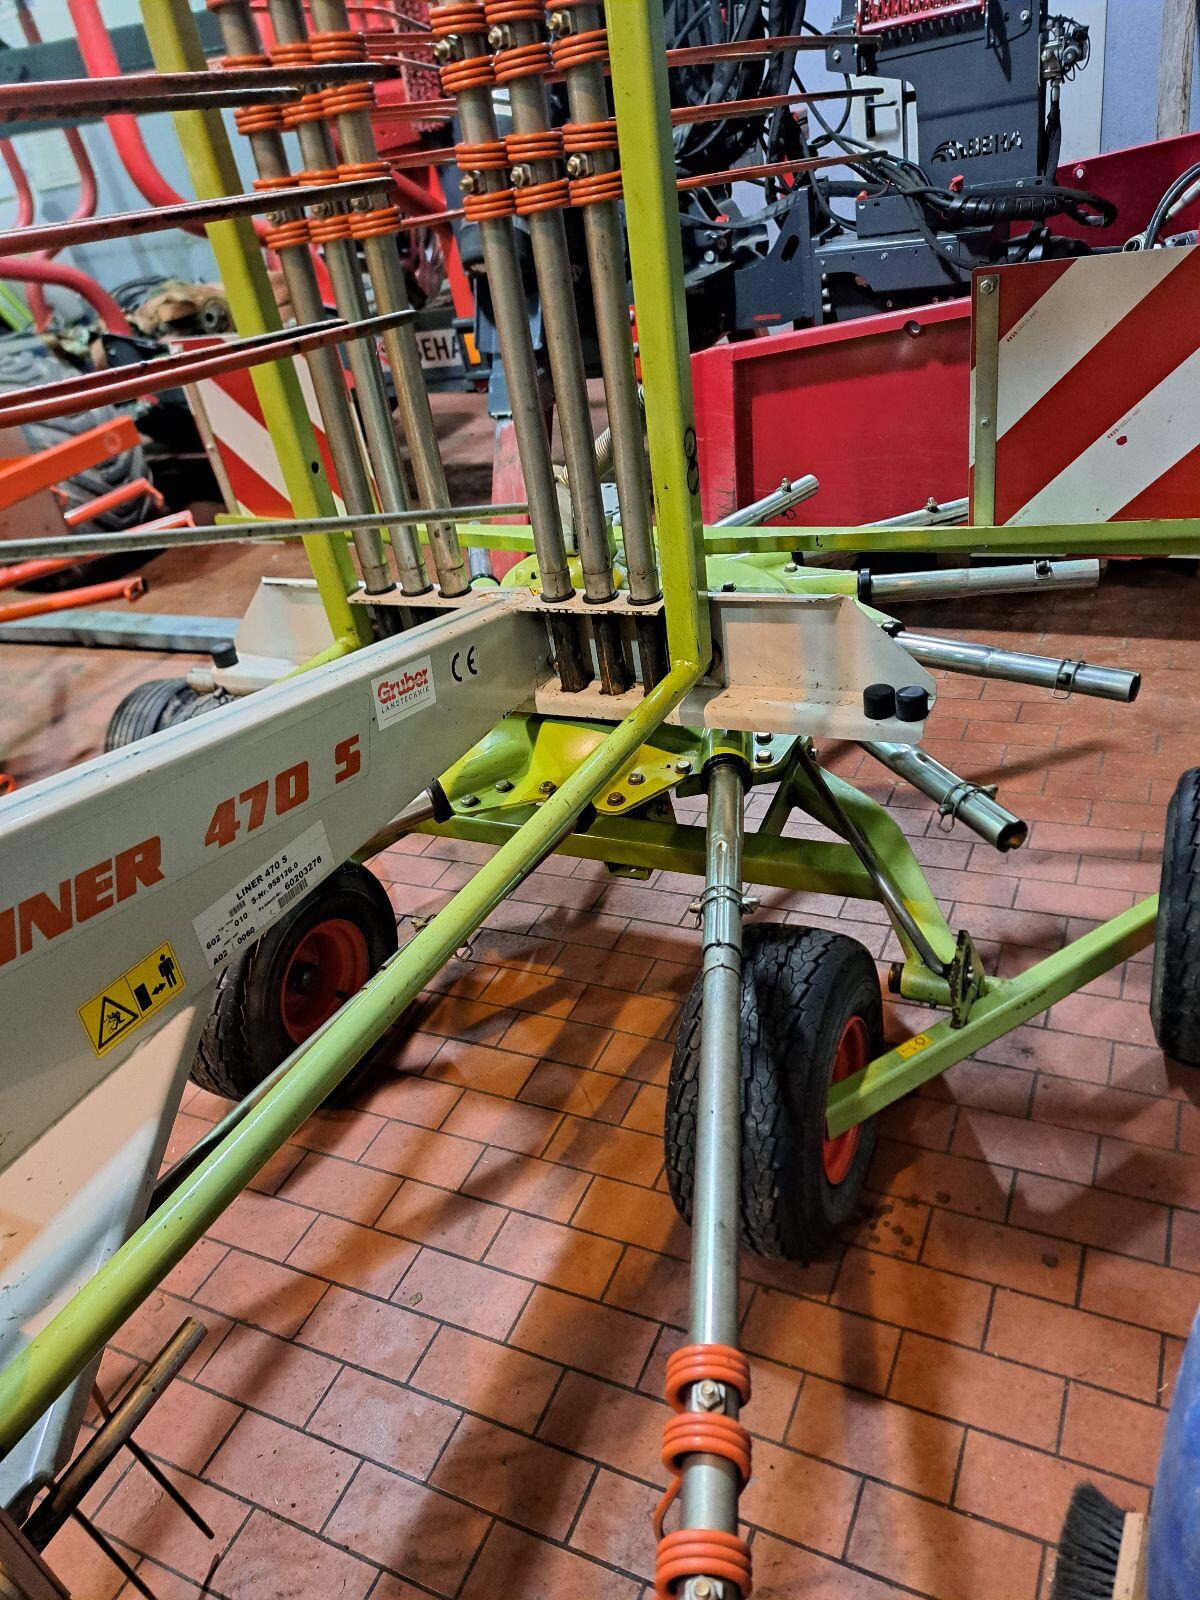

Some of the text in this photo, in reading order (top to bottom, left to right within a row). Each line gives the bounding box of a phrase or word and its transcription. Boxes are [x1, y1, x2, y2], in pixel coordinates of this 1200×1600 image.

[968, 130, 1024, 158] BEHA
[377, 668, 429, 704] Gruber
[381, 686, 430, 714] LANDTECHNIK
[205, 761, 310, 848] 470
[335, 734, 361, 784] S
[236, 855, 288, 900] LINER 470 S
[284, 856, 322, 890] 60203278
[206, 934, 222, 950] 602
[234, 912, 248, 926] 010
[213, 950, 228, 966] A02
[237, 927, 256, 945] 0060
